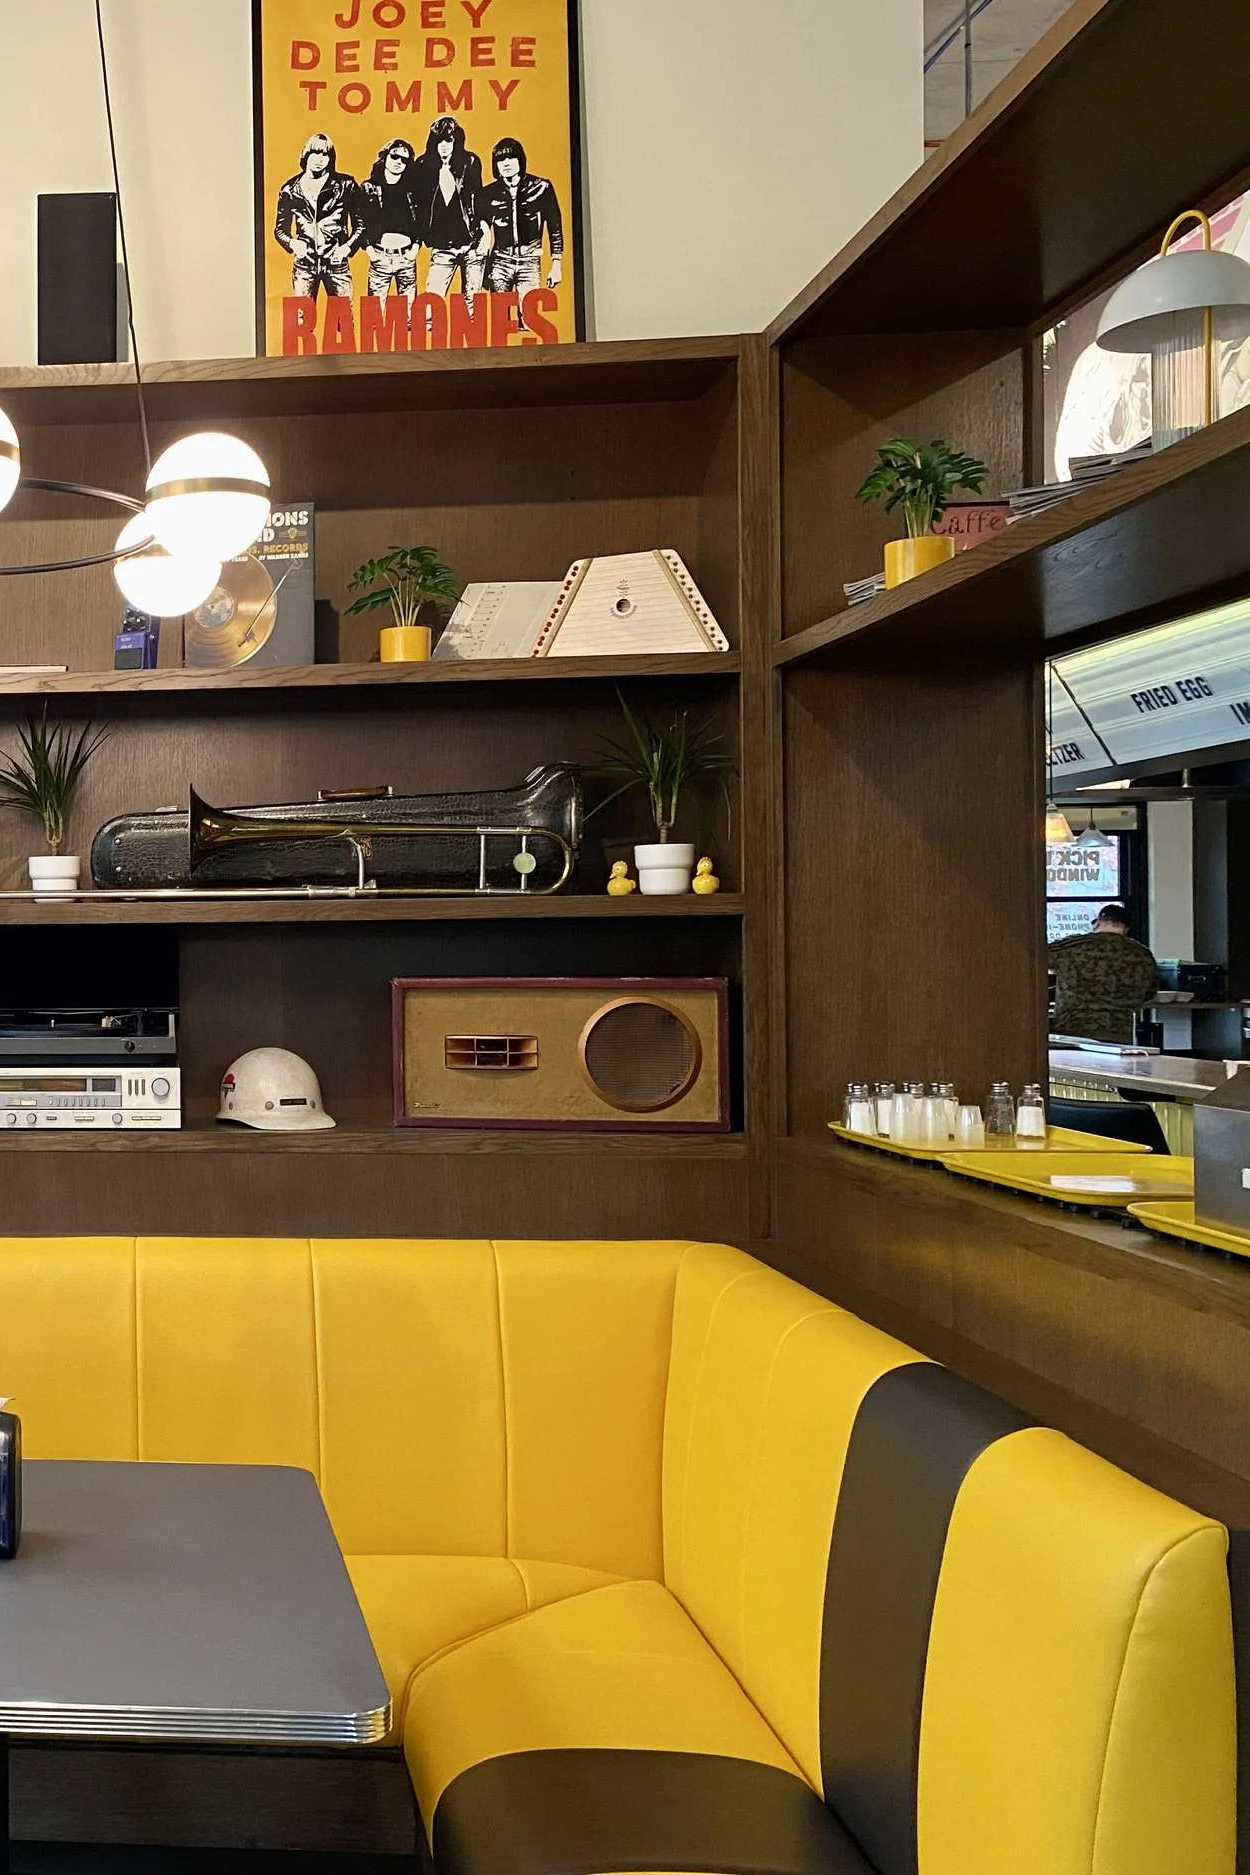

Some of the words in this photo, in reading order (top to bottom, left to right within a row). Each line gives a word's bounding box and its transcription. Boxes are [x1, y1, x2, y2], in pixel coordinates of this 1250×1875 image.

[335, 0, 492, 29] JOEY
[290, 39, 401, 73] DEE
[424, 36, 537, 69] DEE
[299, 79, 521, 114] TOMMY
[282, 289, 559, 356] RAMONES
[263, 542, 309, 554] RECORDS
[1130, 685, 1179, 713] FRIED
[1175, 676, 1213, 702] EGG
